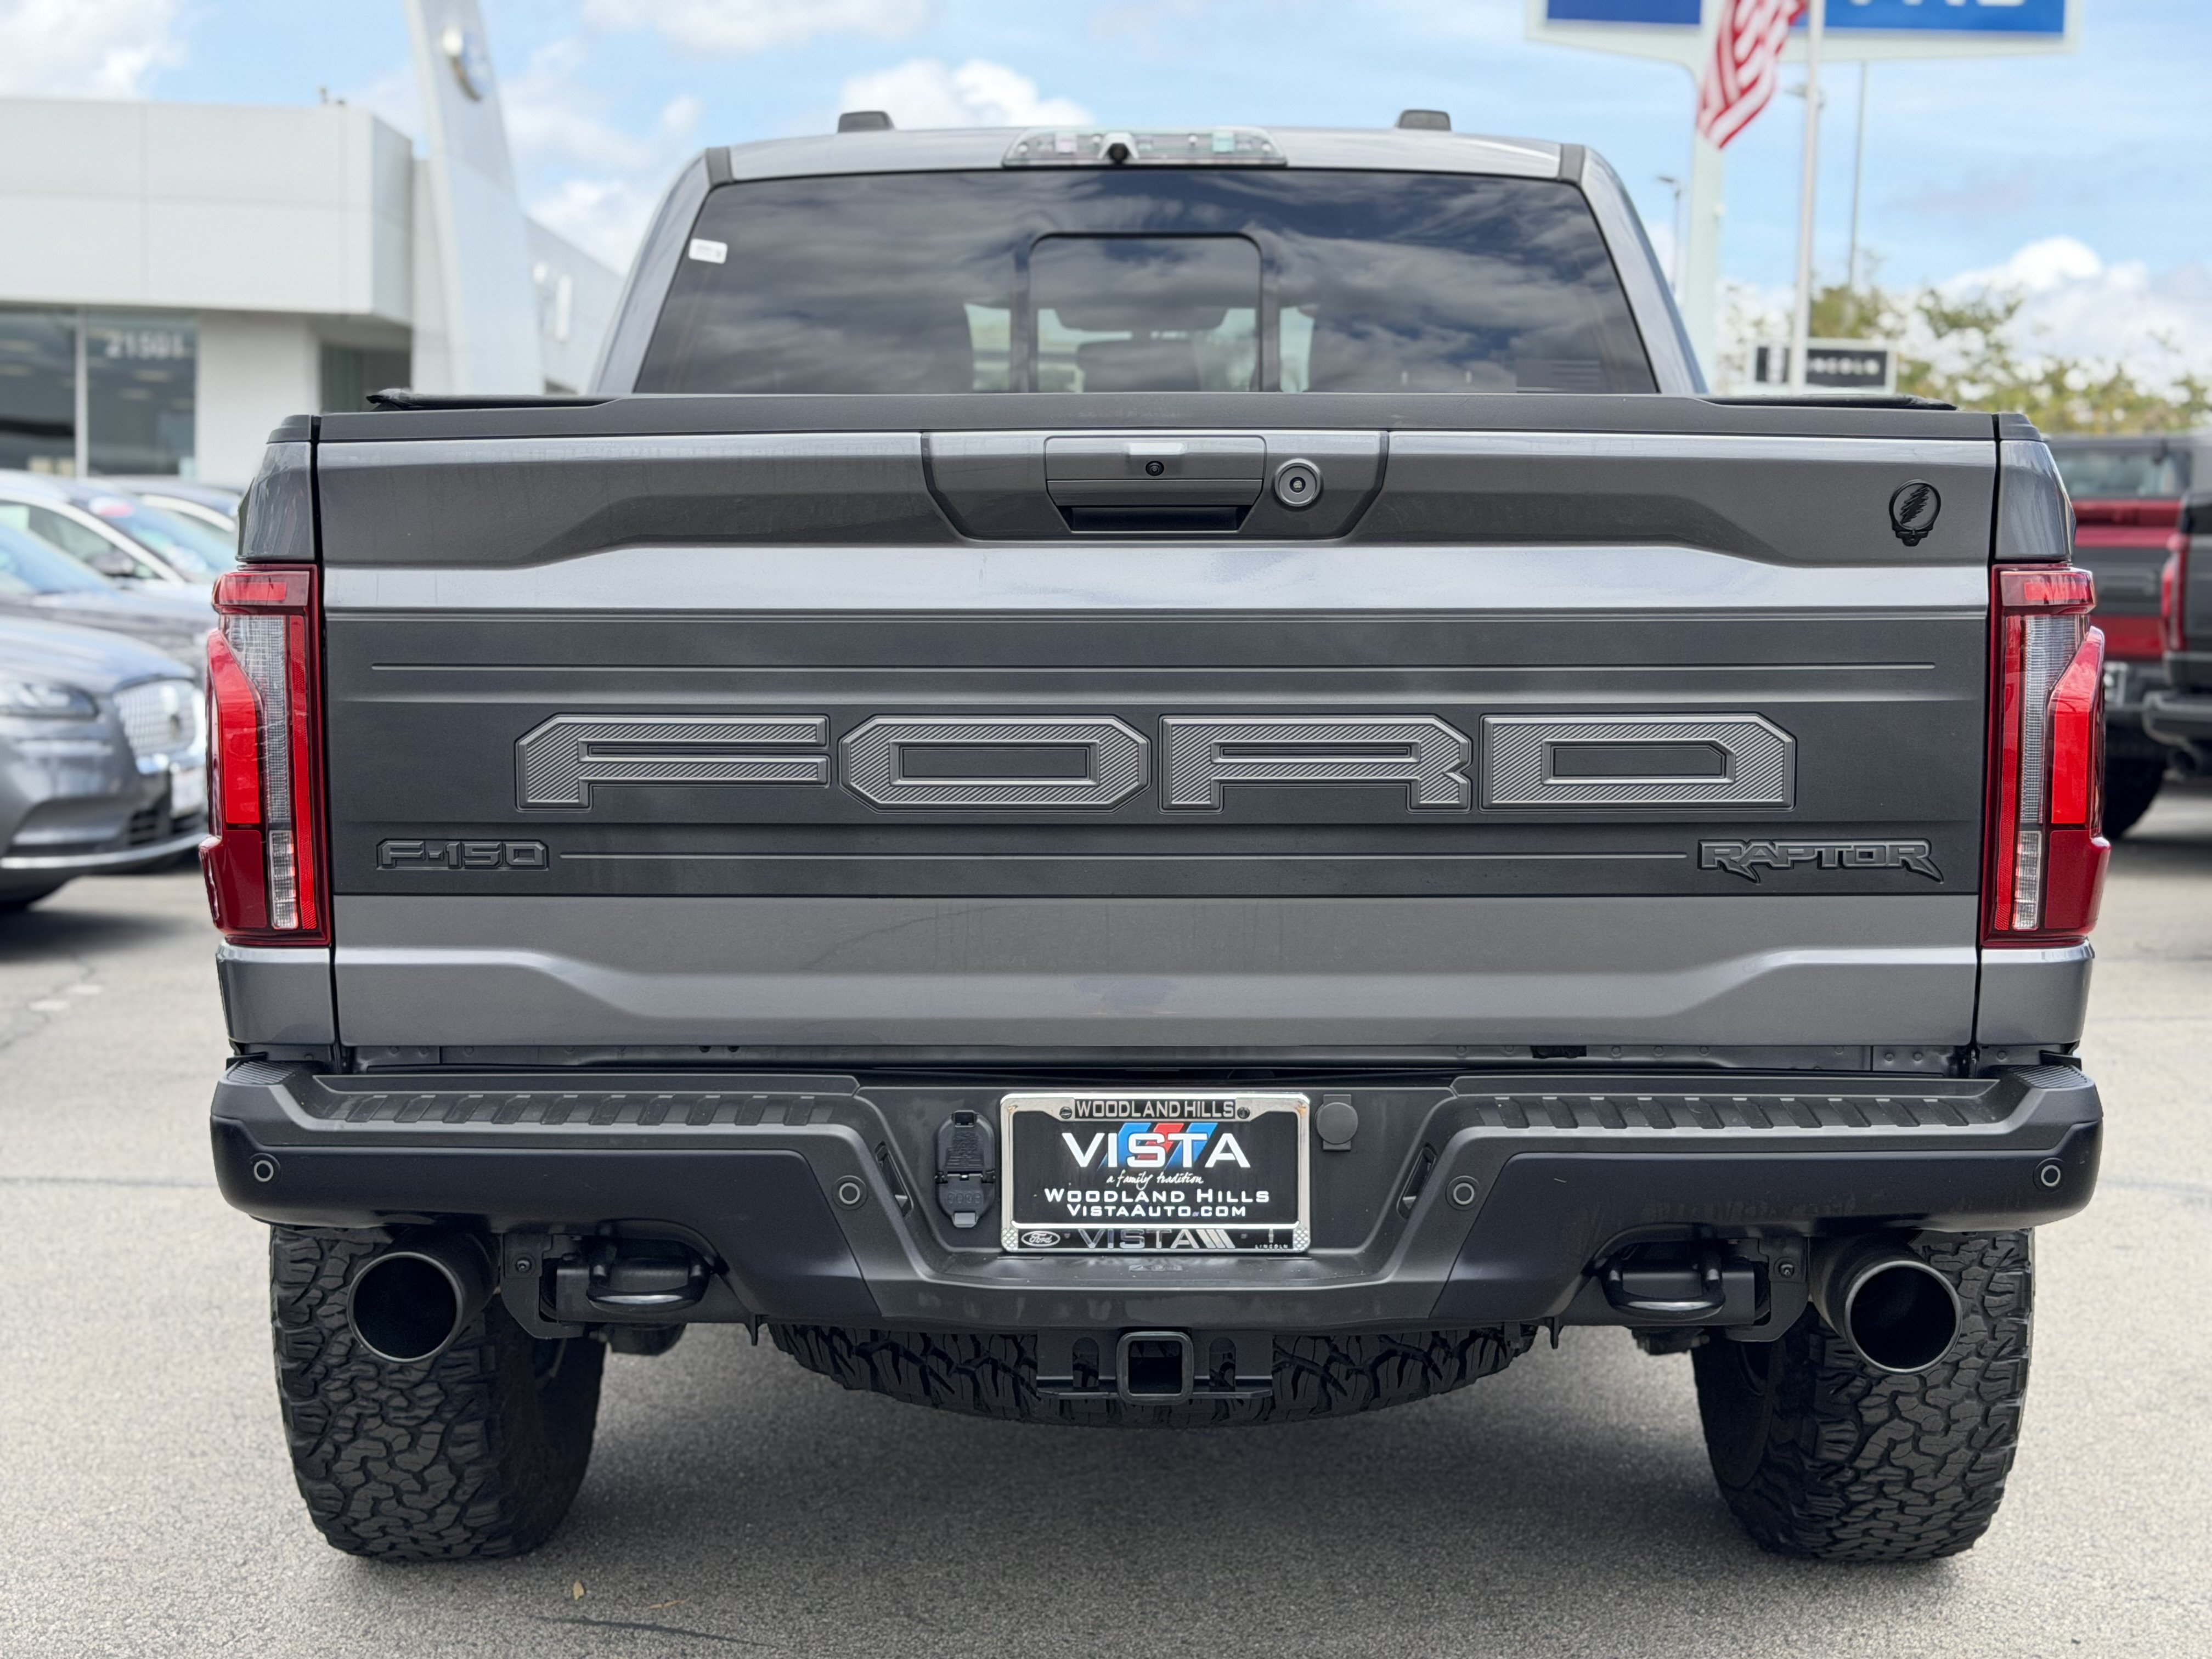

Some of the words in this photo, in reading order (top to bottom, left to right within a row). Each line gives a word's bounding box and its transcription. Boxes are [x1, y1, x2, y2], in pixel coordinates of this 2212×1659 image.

[517, 714, 1797, 811] FORD
[378, 839, 548, 870] F-150
[1699, 839, 1944, 884] RAPTOR
[1076, 1101, 1181, 1118] WOODLAND
[1184, 1101, 1234, 1118] HILLS
[1062, 1132, 1251, 1168] VISTA
[1106, 1174, 1115, 1184] a
[1116, 1170, 1153, 1190] family
[1156, 1171, 1204, 1184] tradition
[1044, 1188, 1185, 1203] WOODLAND
[1197, 1188, 1269, 1203] HILLS
[1029, 1233, 1053, 1244] Ford
[1077, 1228, 1200, 1249] VISTA
